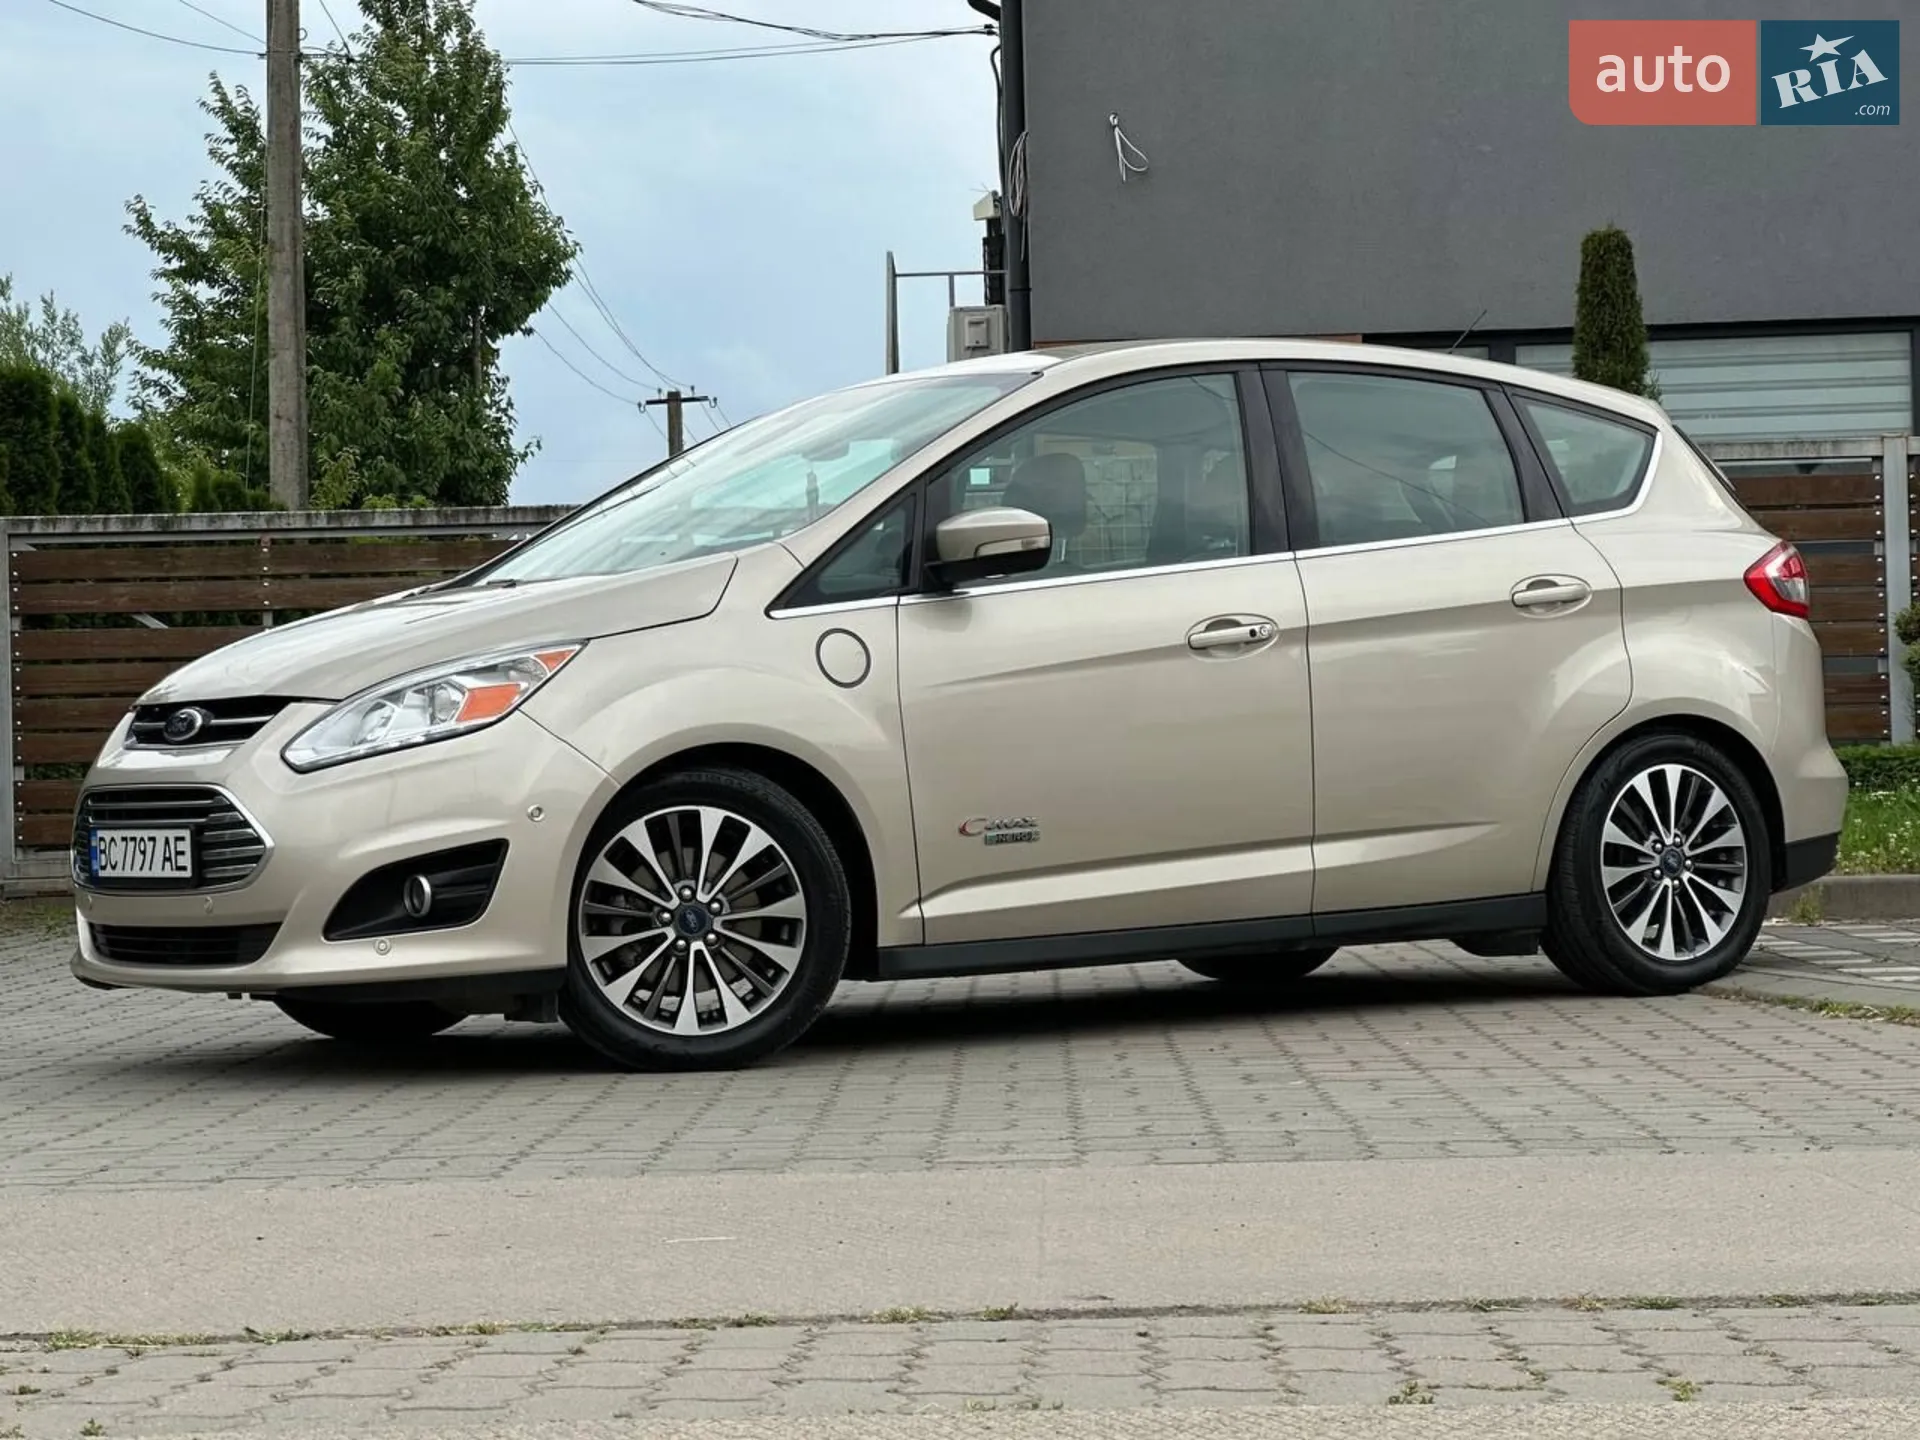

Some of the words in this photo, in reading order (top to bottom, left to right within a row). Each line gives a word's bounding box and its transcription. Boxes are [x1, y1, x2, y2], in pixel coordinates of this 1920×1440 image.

[98, 836, 118, 871] BC
[121, 836, 157, 872] 7797
[161, 836, 188, 872] AE
